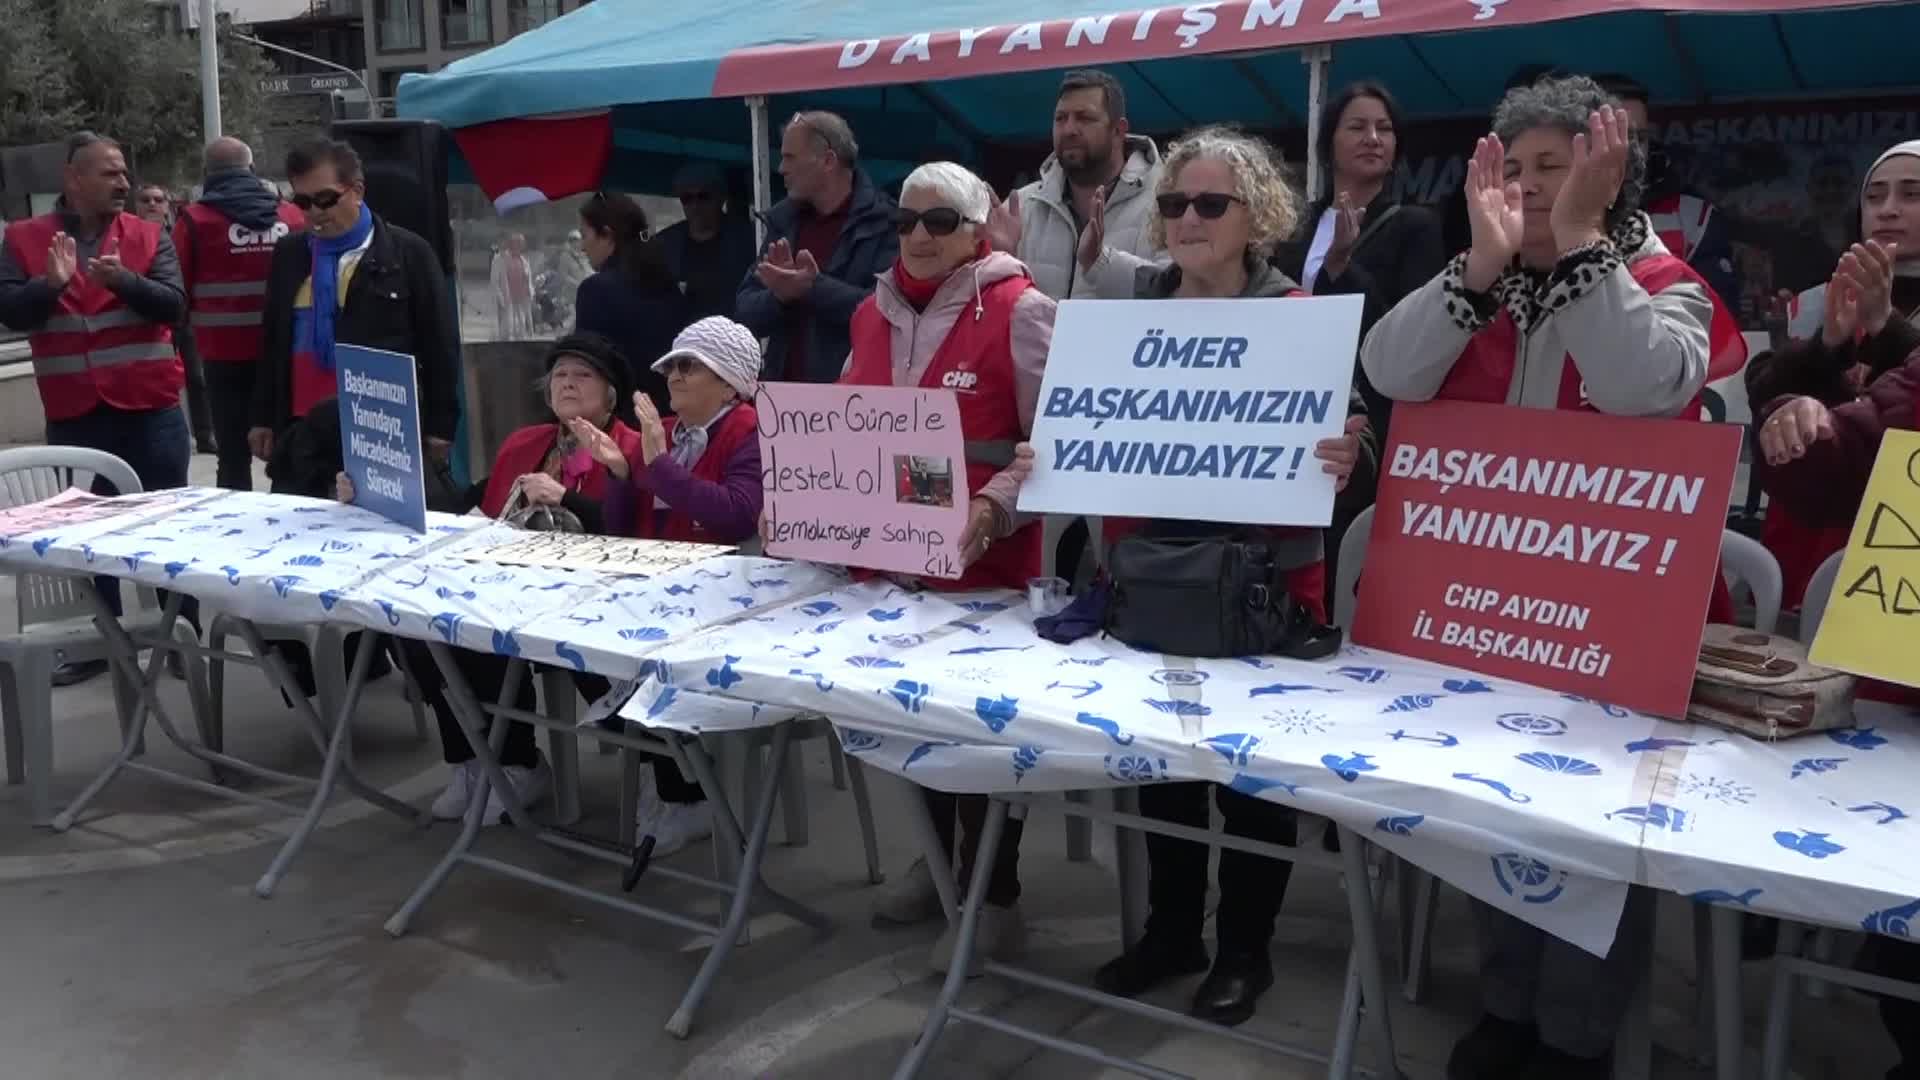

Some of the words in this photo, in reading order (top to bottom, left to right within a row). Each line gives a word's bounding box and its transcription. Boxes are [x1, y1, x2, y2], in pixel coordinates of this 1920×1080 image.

[1131, 328, 1249, 368] ÖMER
[344, 368, 407, 406] Başkanımızın
[942, 371, 977, 388] CHP
[351, 401, 404, 444] Yanındayız,
[845, 392, 945, 433] Günel'e
[1043, 386, 1333, 430] BAŞKANIMIZIN
[350, 431, 412, 472] Mücadelemiz
[762, 445, 850, 493] destek
[856, 446, 882, 494] ol
[1051, 439, 1285, 481] YANINDAYIZ
[366, 467, 405, 504] Sürecek
[1389, 444, 1705, 515] BAŞKANIMIZIN
[766, 500, 872, 550] demokrasiye
[1400, 500, 1651, 572] YANINDAYIZ
[1654, 538, 1679, 577] !
[1444, 582, 1502, 613] CHP
[1502, 594, 1591, 631] AYDIN
[1411, 610, 1435, 640] İL
[1440, 622, 1612, 678] BAŞKANLIĞI
